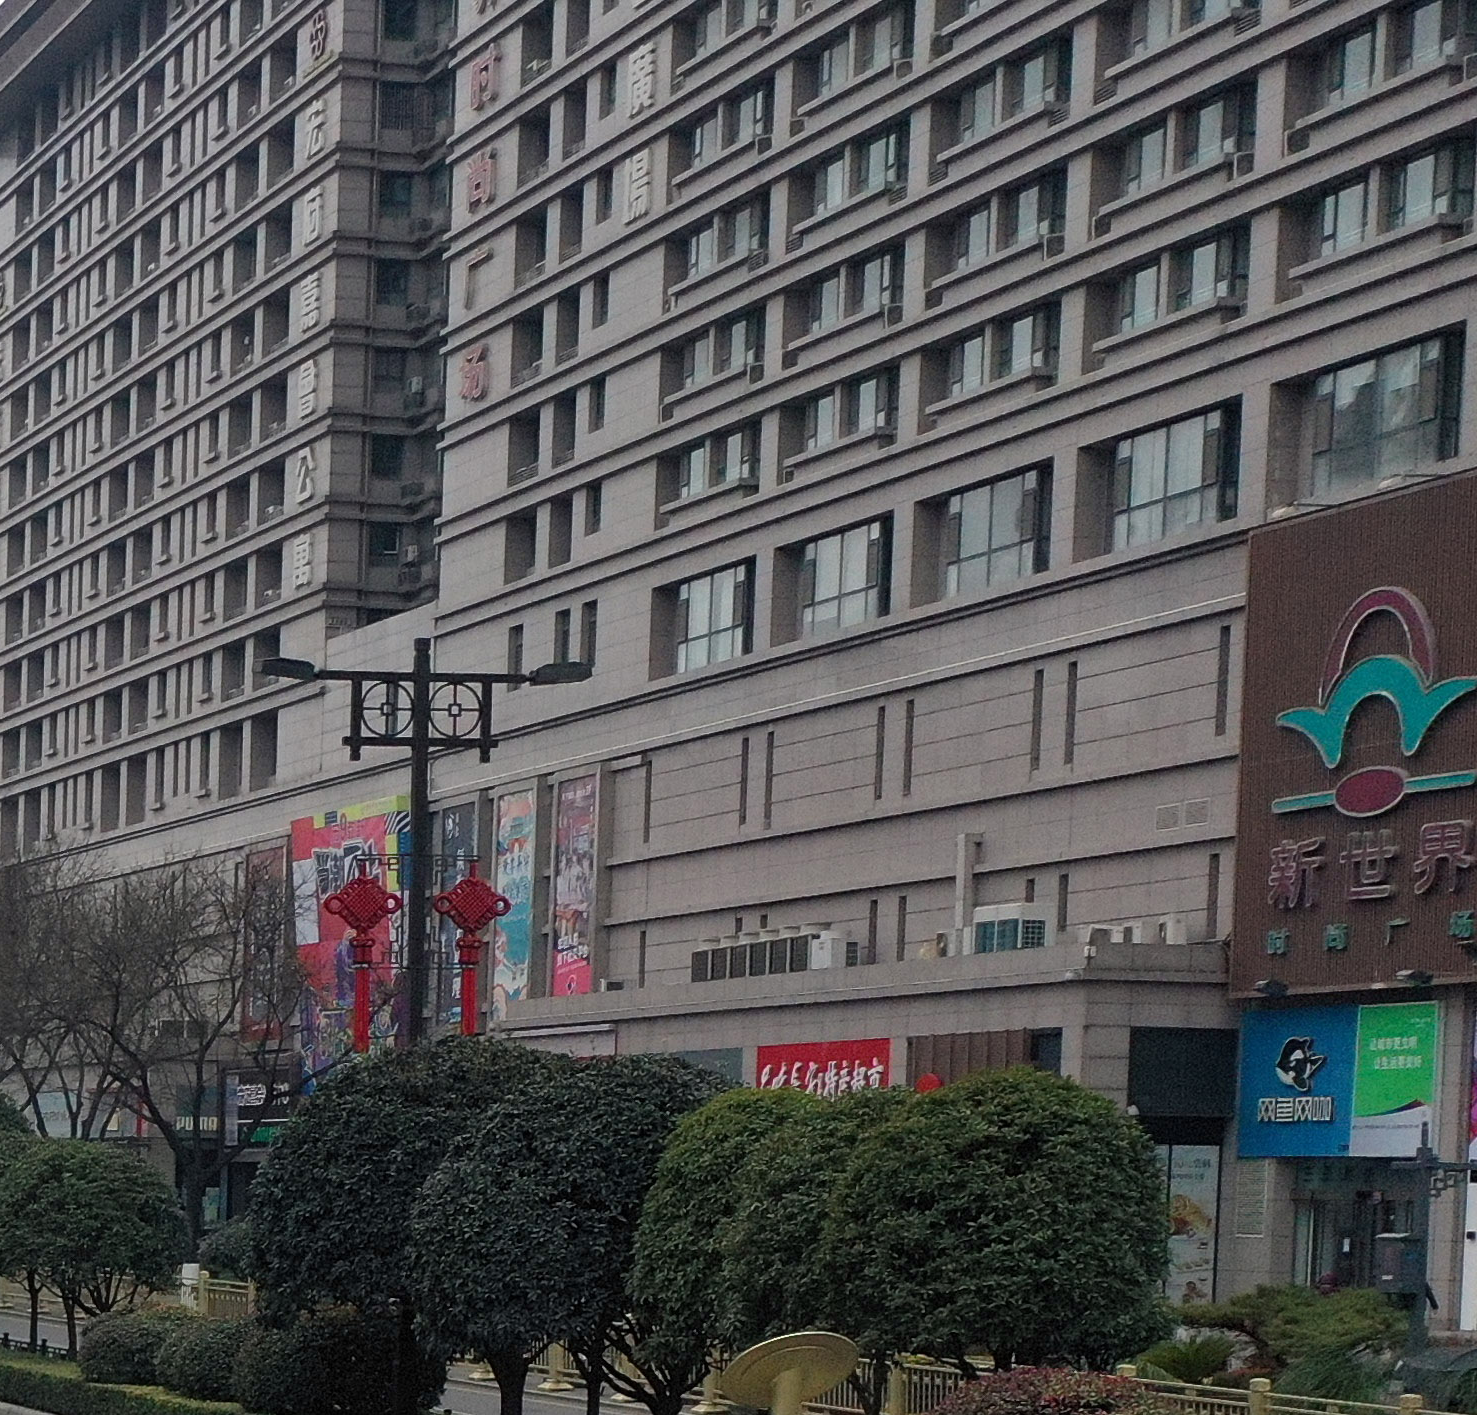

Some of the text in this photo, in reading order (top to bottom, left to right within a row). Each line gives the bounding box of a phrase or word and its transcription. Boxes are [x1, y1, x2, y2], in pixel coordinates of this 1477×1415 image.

[458, 0, 503, 400] 时尚广场
[1267, 819, 1477, 909] 新世界
[1266, 911, 1474, 954] 时尚广场
[1258, 1096, 1333, 1122] 网鱼网咖
